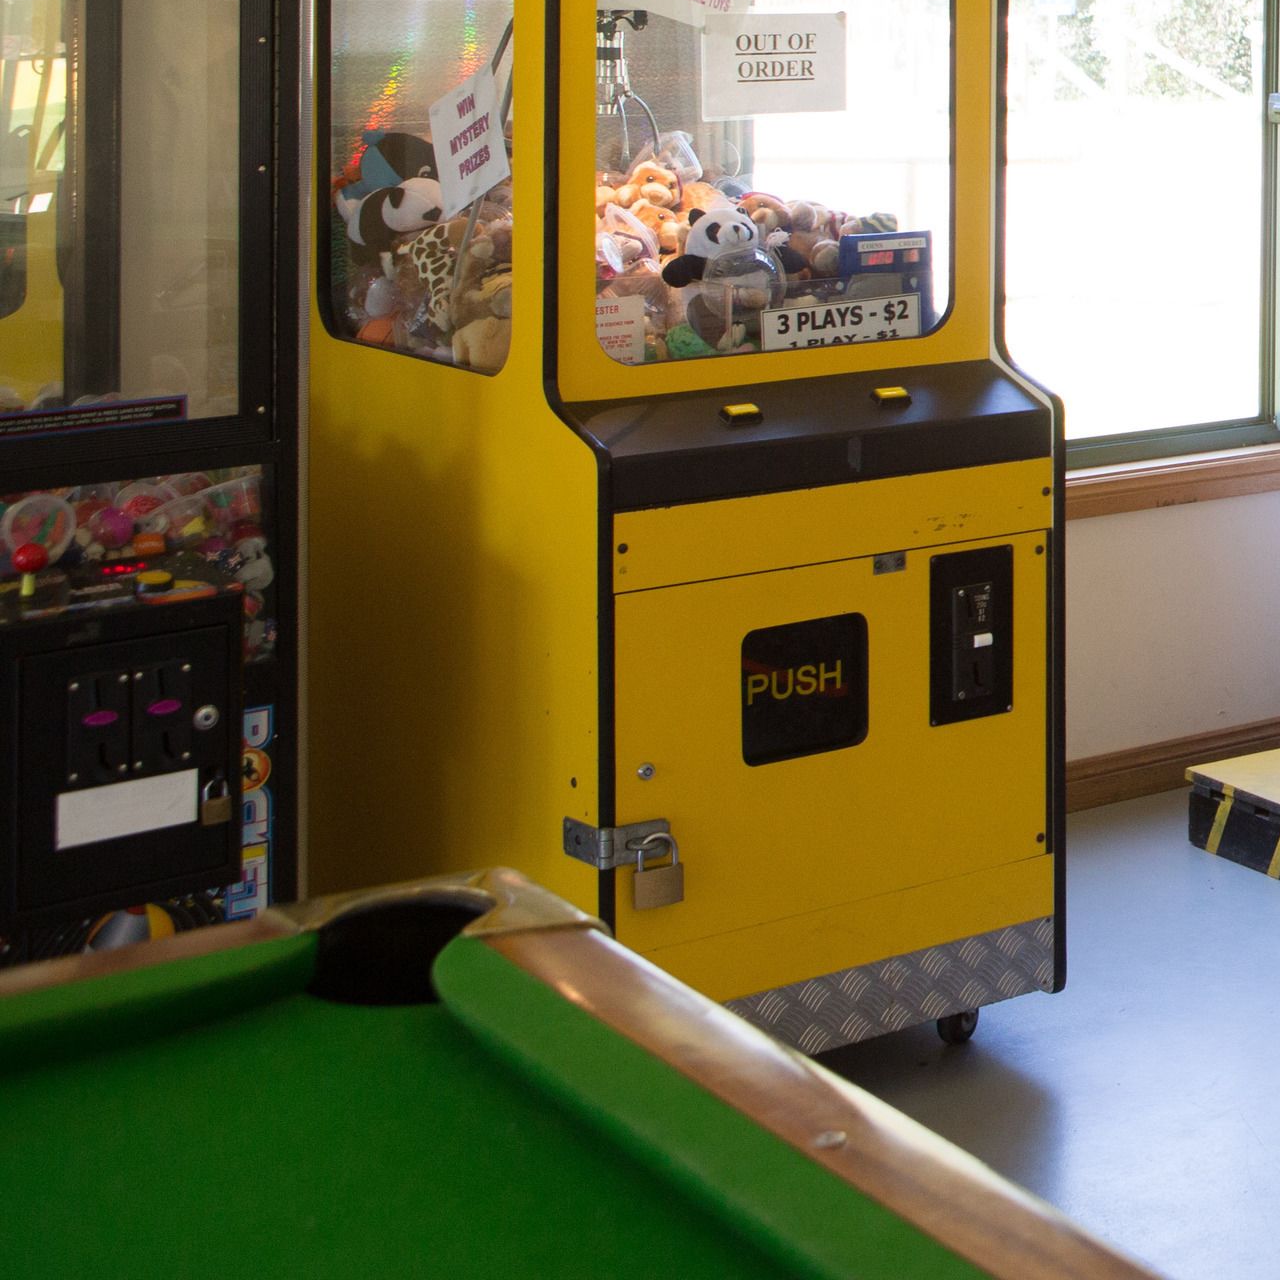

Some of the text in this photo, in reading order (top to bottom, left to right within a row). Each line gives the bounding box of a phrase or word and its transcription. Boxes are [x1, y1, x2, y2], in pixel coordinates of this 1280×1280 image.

[736, 33, 816, 52] OUT OF
[738, 60, 814, 78] ORDER
[457, 93, 476, 119] WIN
[449, 112, 489, 156] MYSTERY
[459, 144, 490, 180] PRIZES
[777, 314, 790, 335] 3
[797, 305, 863, 332] PLAYS
[884, 300, 909, 326] $2
[807, 334, 857, 347] PLAY
[877, 329, 900, 340] $1
[747, 659, 842, 705] PUSH
